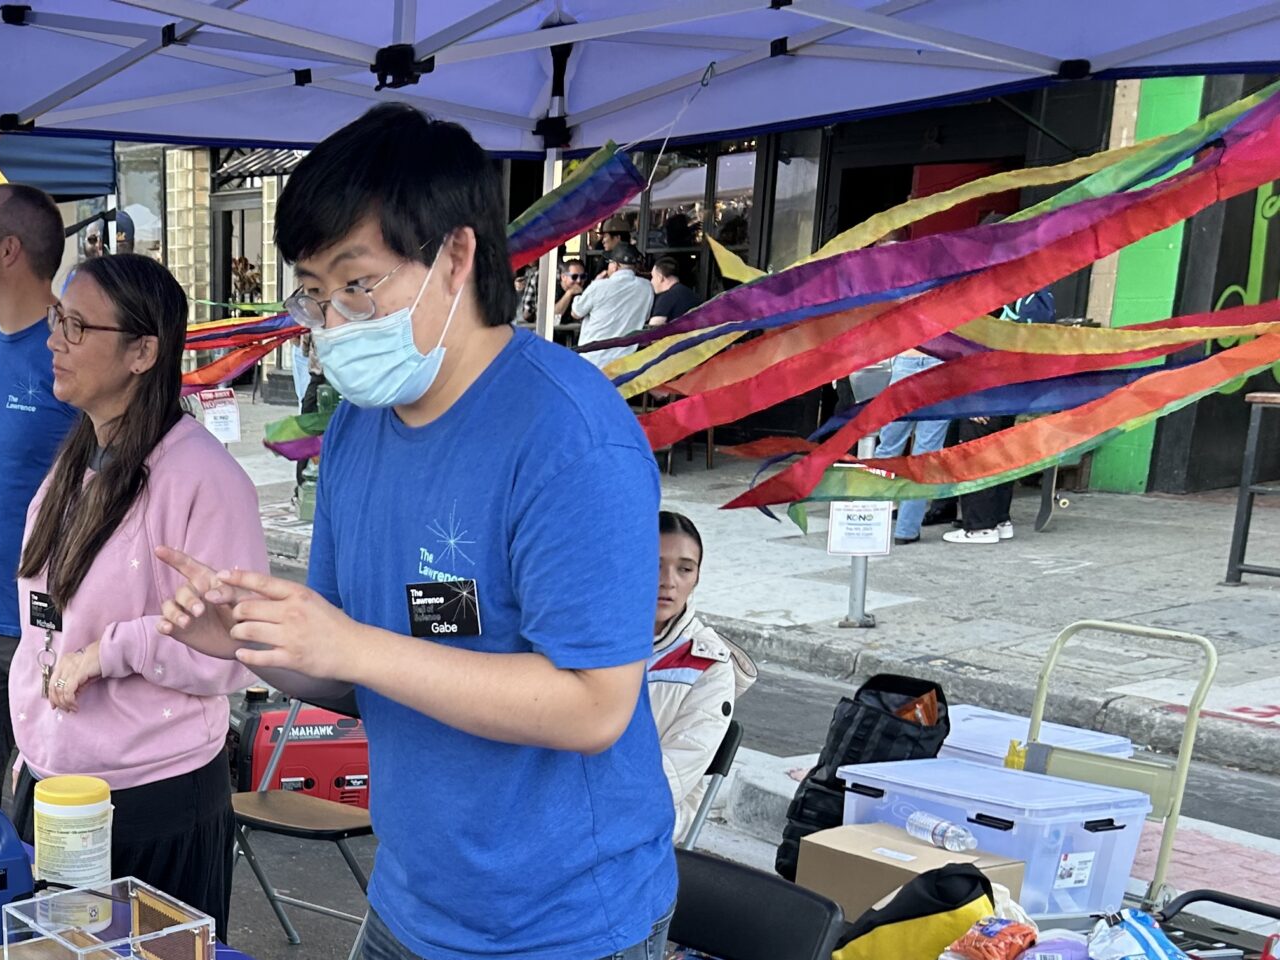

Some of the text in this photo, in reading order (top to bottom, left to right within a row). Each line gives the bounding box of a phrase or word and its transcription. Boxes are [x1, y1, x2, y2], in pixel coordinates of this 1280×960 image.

[6, 402, 37, 412] Lawrence
[420, 547, 433, 563] The
[410, 589, 423, 597] The
[411, 597, 444, 605] Lawrence
[431, 622, 458, 633] Gabe
[277, 726, 333, 736] TMAHAWK
